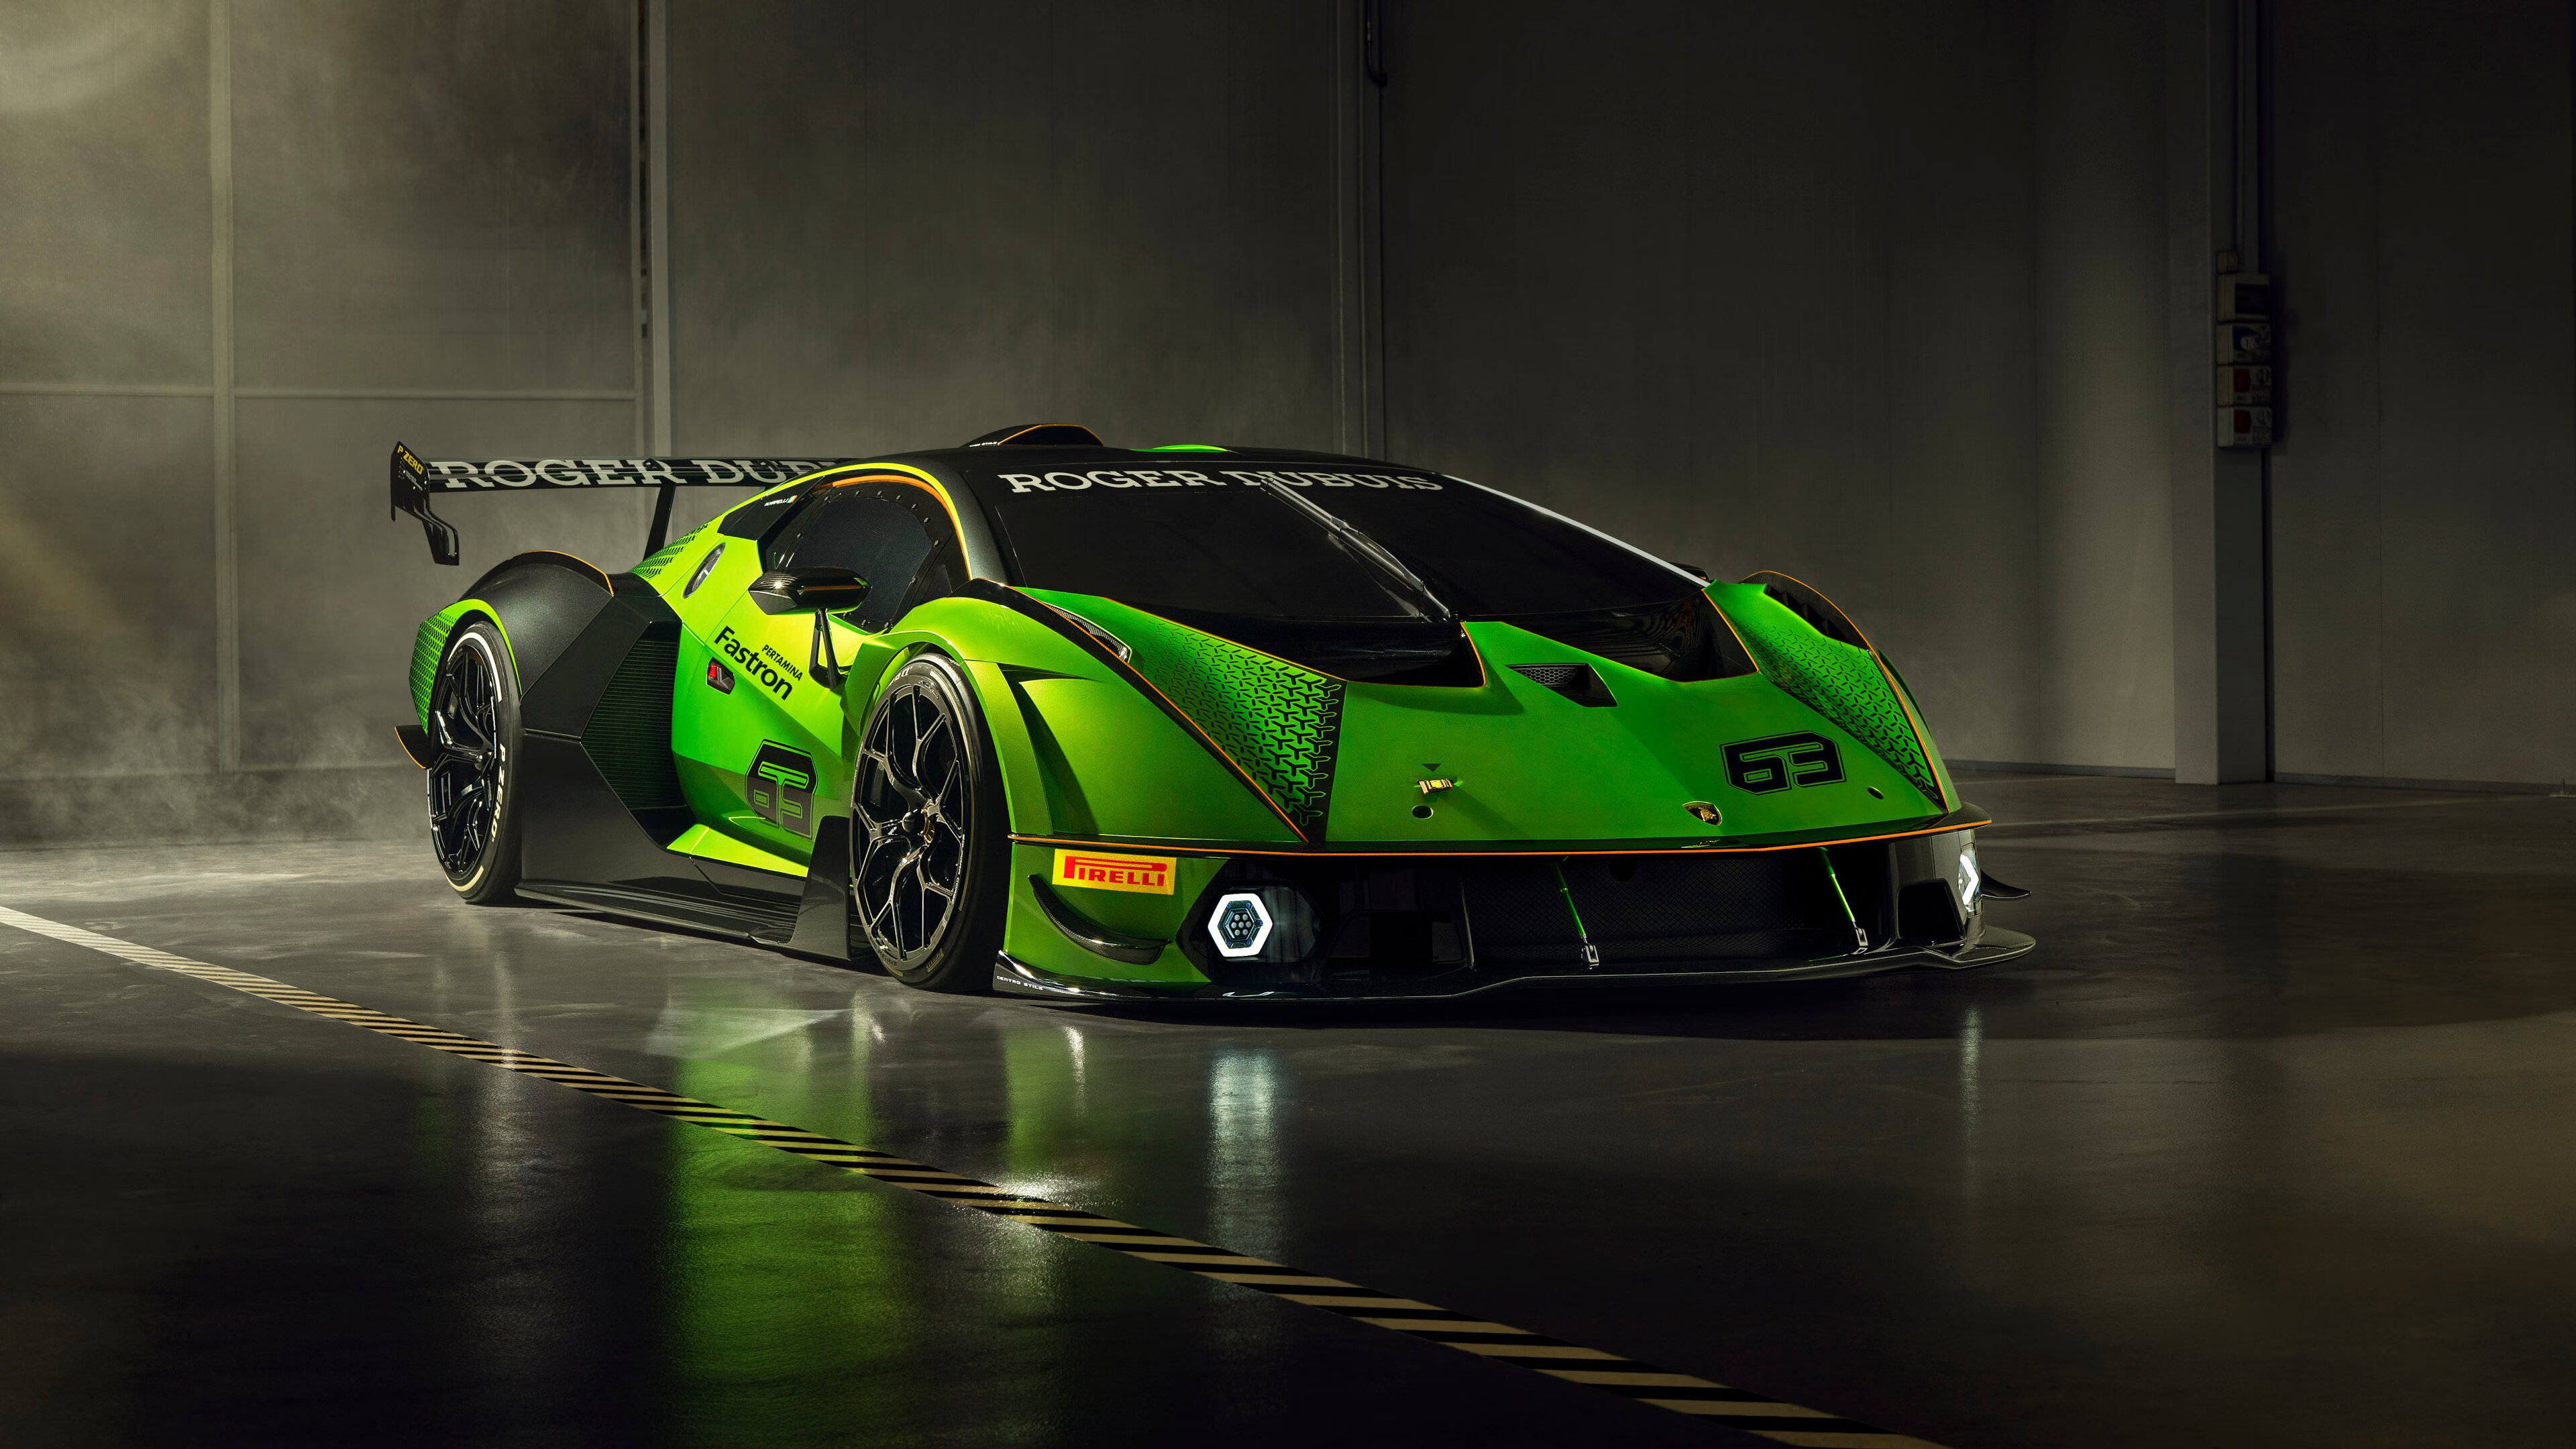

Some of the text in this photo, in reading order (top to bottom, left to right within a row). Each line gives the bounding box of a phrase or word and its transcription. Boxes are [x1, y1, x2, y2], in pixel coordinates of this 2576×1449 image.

[397, 445, 404, 453] P
[403, 450, 424, 475] ZERO
[430, 459, 688, 488] ROGER
[998, 470, 1443, 493] ROGER DUBUIS
[714, 625, 793, 701] Fastron
[761, 644, 803, 682] PERTAMINA
[500, 743, 506, 762] P
[1719, 730, 1847, 796] 63
[491, 766, 504, 839] ZERO
[745, 739, 818, 841] 63
[1063, 855, 1167, 887] PIRELLI
[996, 975, 1043, 991] CENTRO STILE
